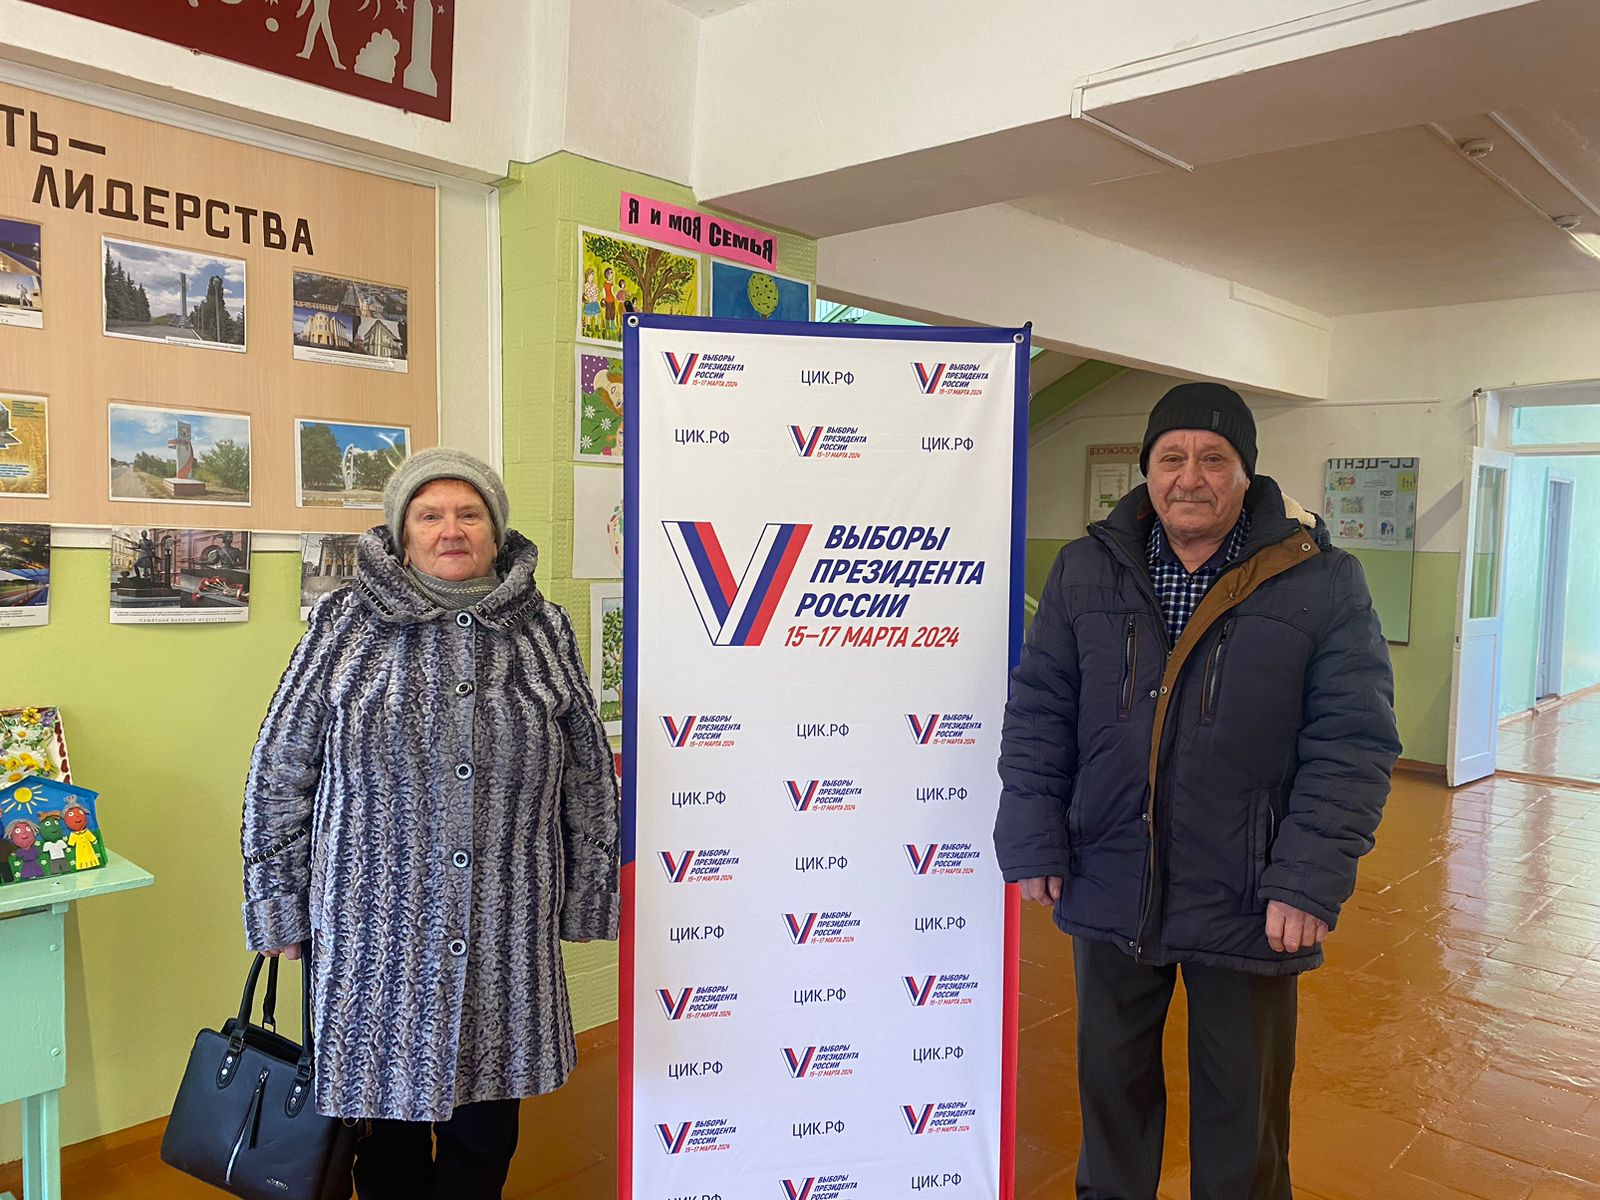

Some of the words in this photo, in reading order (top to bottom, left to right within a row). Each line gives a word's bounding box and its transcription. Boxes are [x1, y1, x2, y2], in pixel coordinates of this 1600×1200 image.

[31, 164, 314, 256] ЛИДЕРСТВА
[628, 197, 640, 225] Я
[702, 354, 735, 362] ВЫБОРЫ
[695, 371, 724, 379] РОССИИ
[699, 363, 744, 371] ПРЕЗИДЕНТА
[801, 369, 855, 386] ЦИК.РФ
[945, 372, 988, 380] ПРЕЗИДЕНТА
[674, 428, 730, 445] ЦИК.РФ
[823, 435, 866, 443] ПРЕЗИДЕНТА
[921, 436, 974, 452] ЦИК.РФ
[824, 525, 950, 550] ВЫБОРЫ
[810, 559, 985, 587] ПРЕЗИДЕНТА
[795, 593, 910, 617] РОССИИ
[841, 627, 909, 647] МАРТА
[911, 627, 959, 647] 2024
[796, 723, 850, 739] ЦИК.РФ
[671, 790, 727, 808] ЦИК.РФ
[916, 786, 968, 803] ЦИК.РФ
[795, 855, 848, 872] ЦИК.РФ
[914, 915, 966, 933] ЦИК.РФ
[669, 924, 725, 943] ЦИК.РФ
[693, 994, 737, 1002] ПРЕЗИДЕНТА
[793, 987, 847, 1005] ЦИК.РФ
[689, 1003, 718, 1011] РОССИИ
[816, 1052, 858, 1061] ПРЕЗИДЕНТА
[913, 1045, 964, 1063] ЦИК.РФ
[668, 1060, 723, 1079] ЦИК.РФ
[934, 1109, 975, 1118] ПРЕЗИДЕНТА
[691, 1127, 736, 1136] ПРЕЗИДЕНТА
[695, 1119, 727, 1127] ВЫБОРЫ
[792, 1119, 845, 1138] ЦИК.РФ
[688, 1137, 717, 1145] РОССИИ
[814, 1182, 857, 1192] ПРЕЗИДЕНТА
[818, 1175, 848, 1183] ВЫБОРЫ
[911, 1172, 962, 1191] ЦИК.РФ
[811, 1192, 839, 1200] РОССИИ
